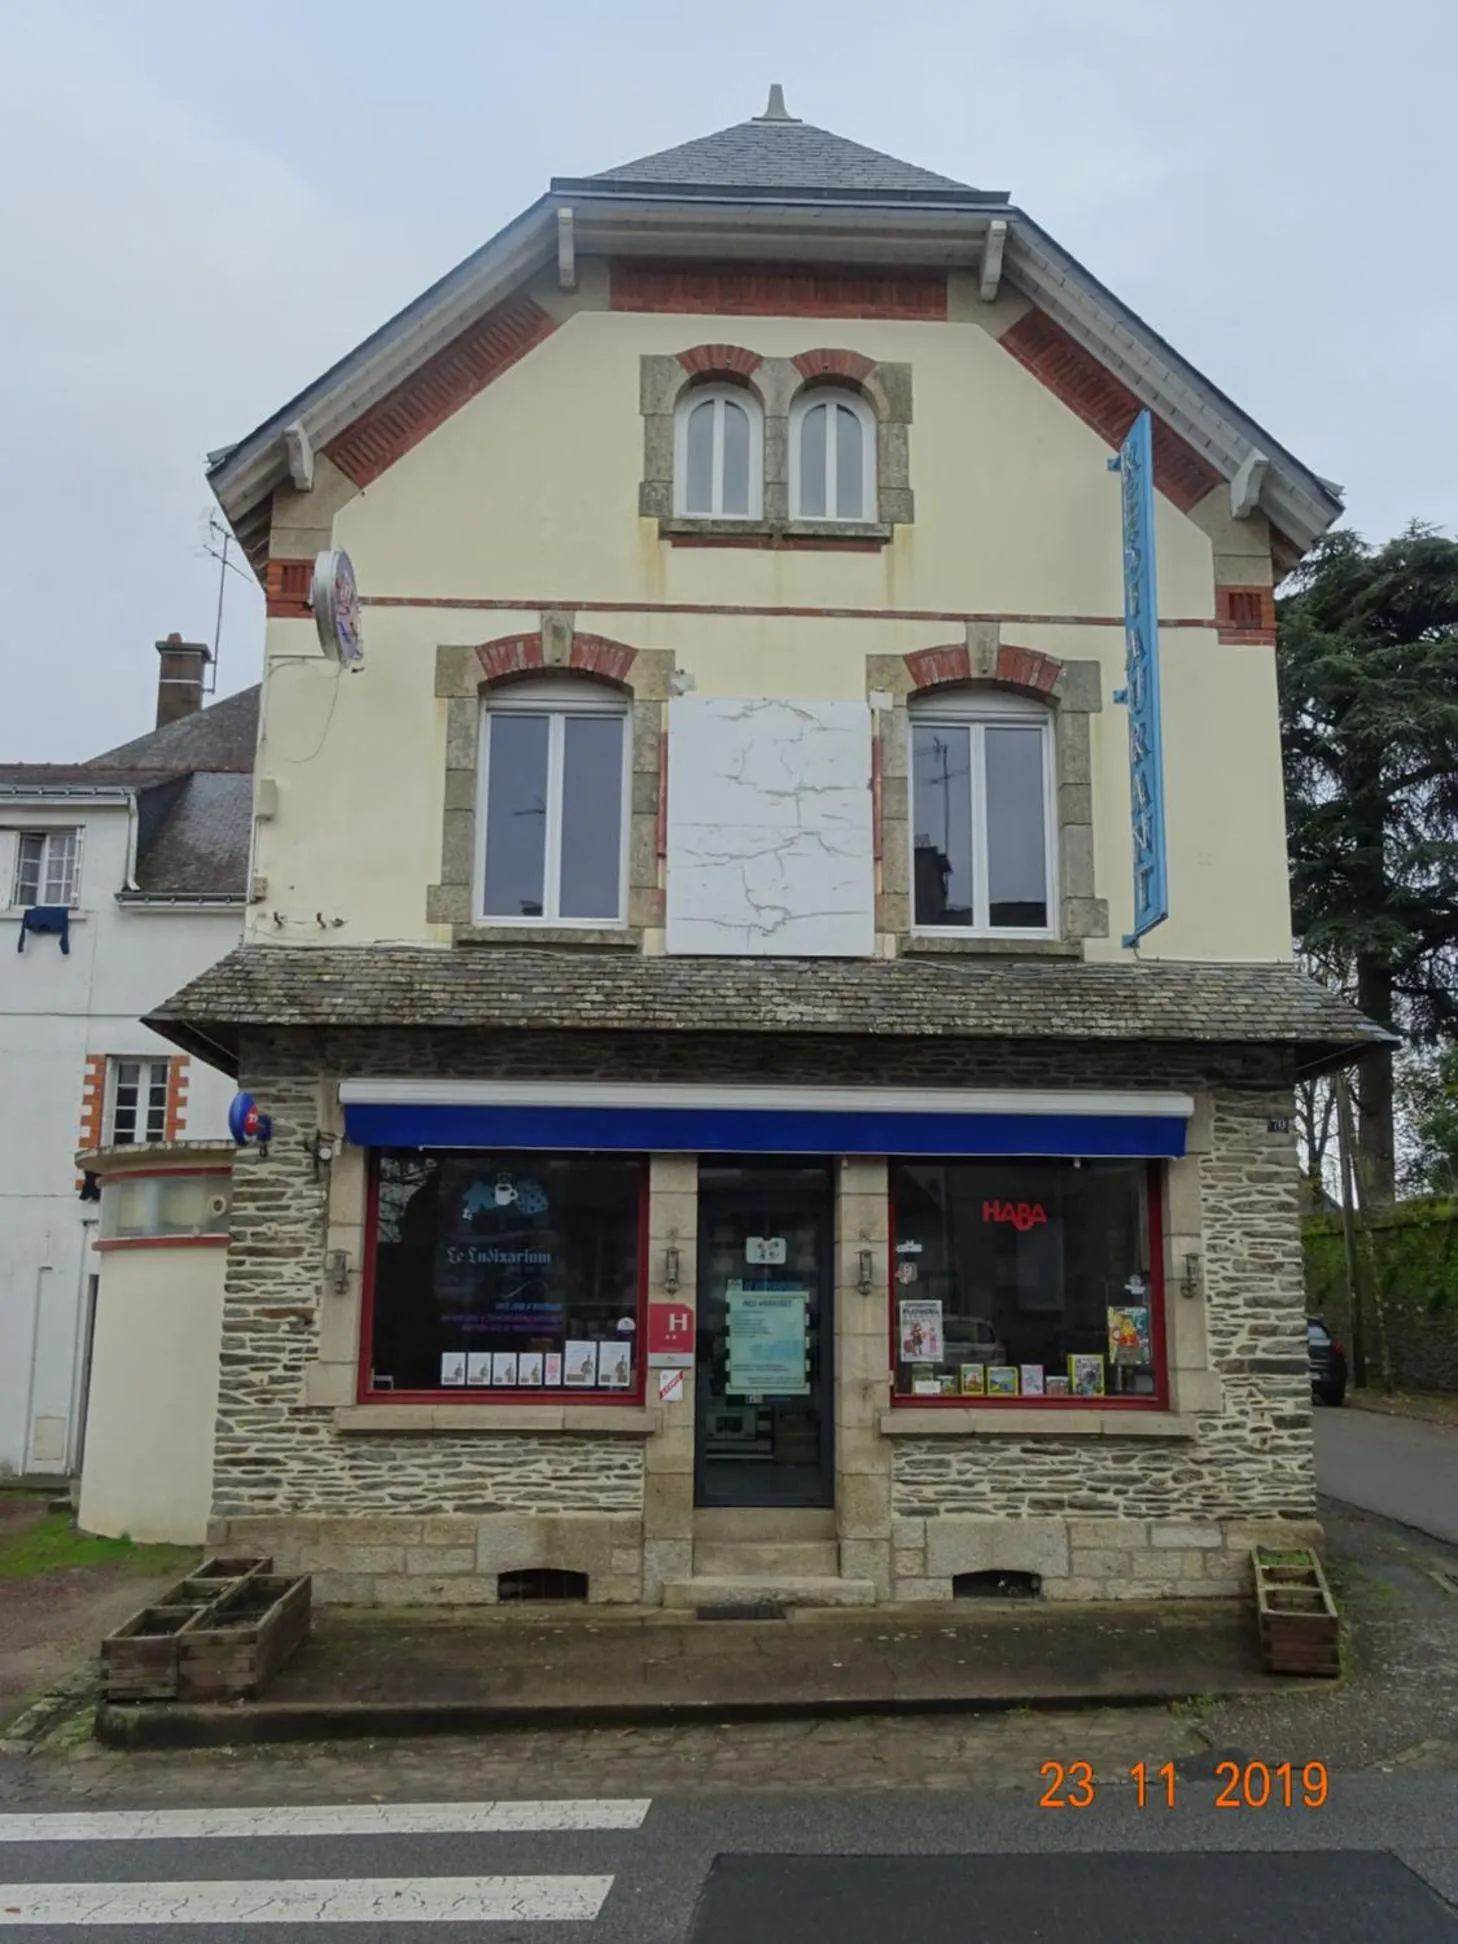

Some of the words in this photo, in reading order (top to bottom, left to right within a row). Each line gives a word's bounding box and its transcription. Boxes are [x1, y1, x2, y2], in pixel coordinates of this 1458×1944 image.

[1271, 1118, 1287, 1130] 70
[982, 1200, 1048, 1231] HABA
[447, 1246, 465, 1265] Le
[669, 1313, 688, 1332] H
